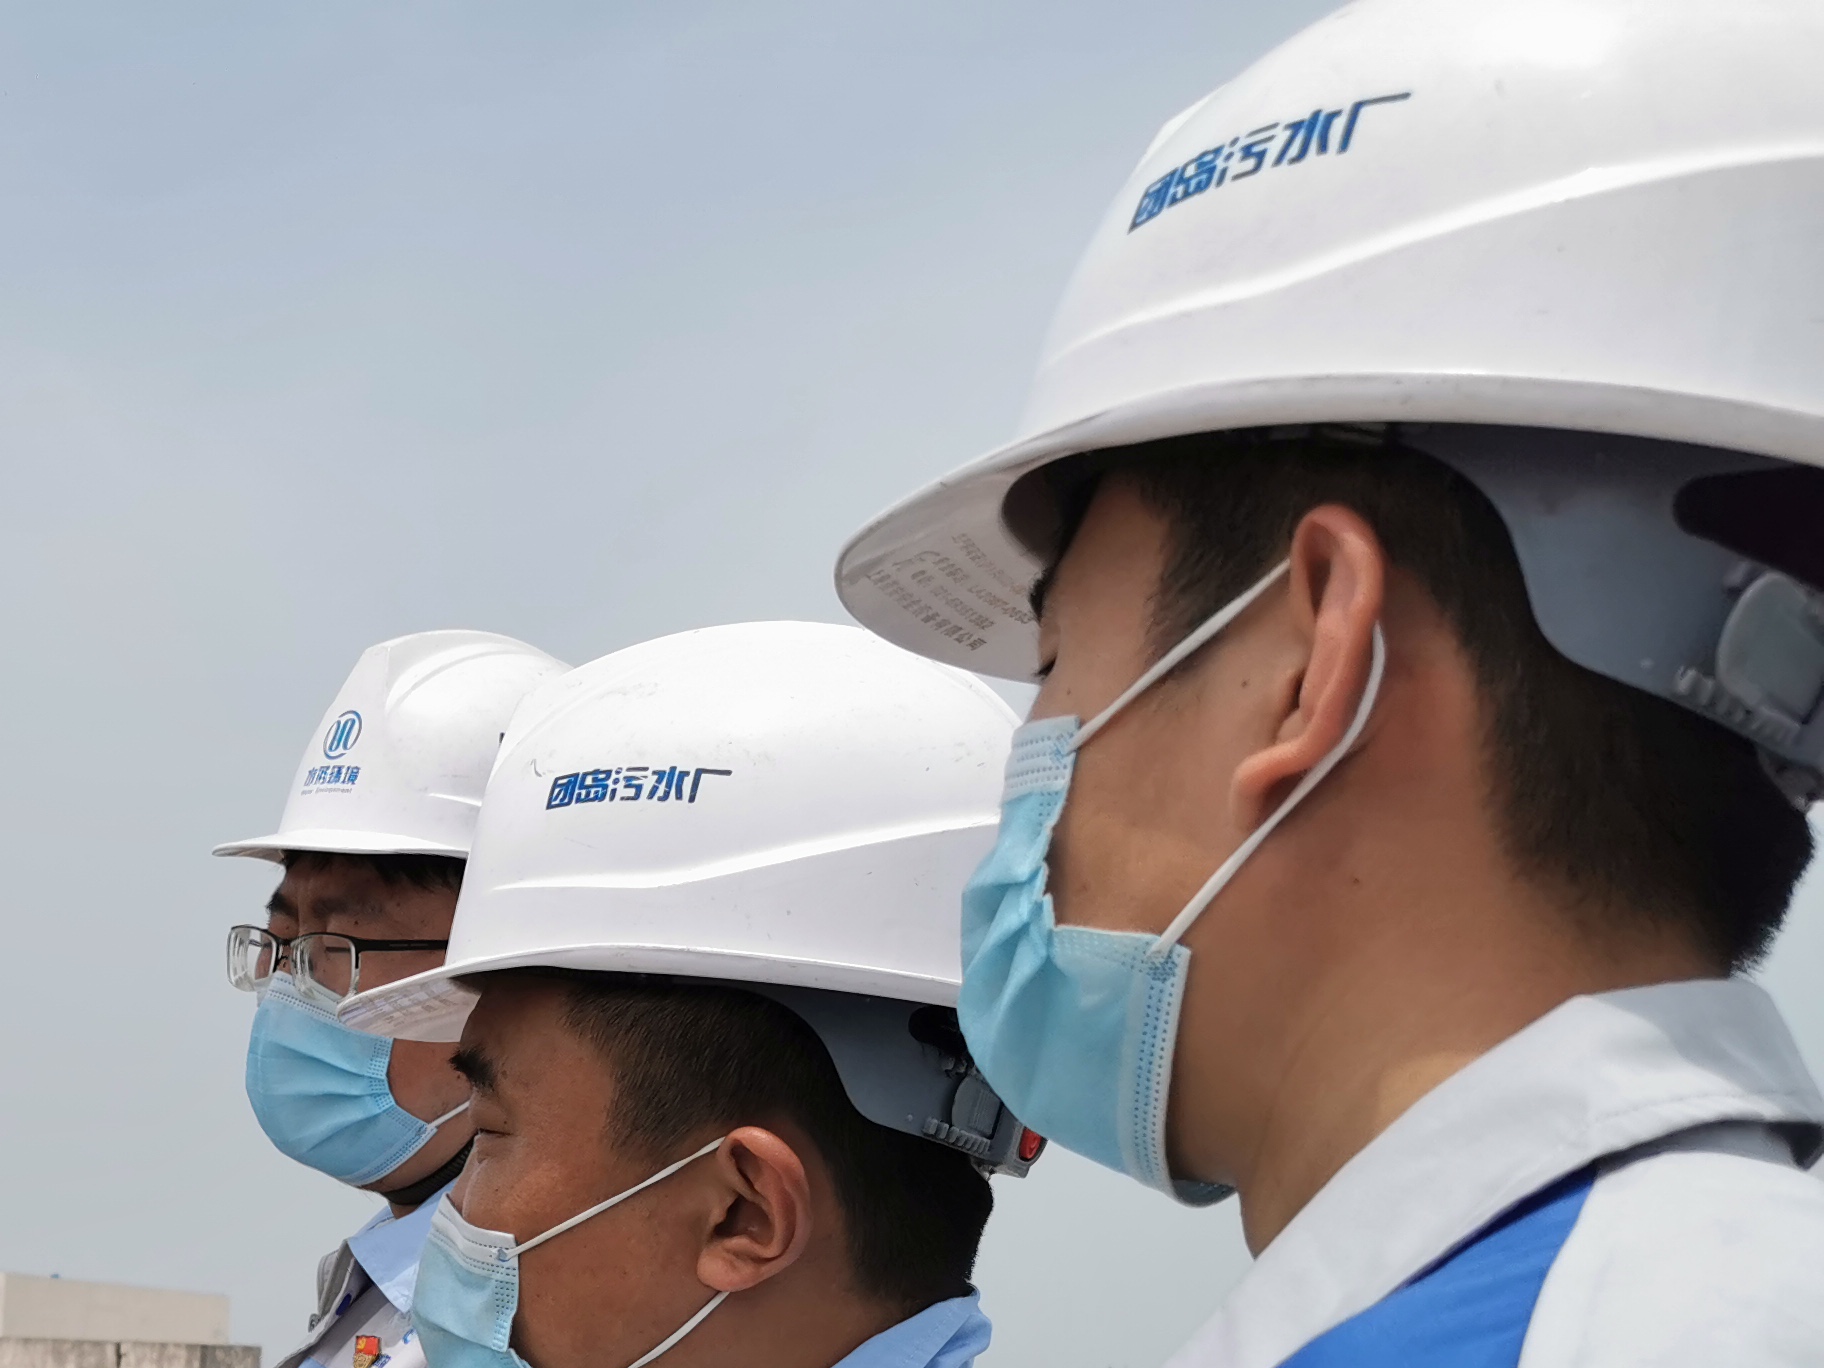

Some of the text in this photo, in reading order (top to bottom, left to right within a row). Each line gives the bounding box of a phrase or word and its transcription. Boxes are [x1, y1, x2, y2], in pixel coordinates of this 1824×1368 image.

[1126, 92, 1412, 235] 团岛污水厂
[545, 765, 732, 810] 团岛污水厂
